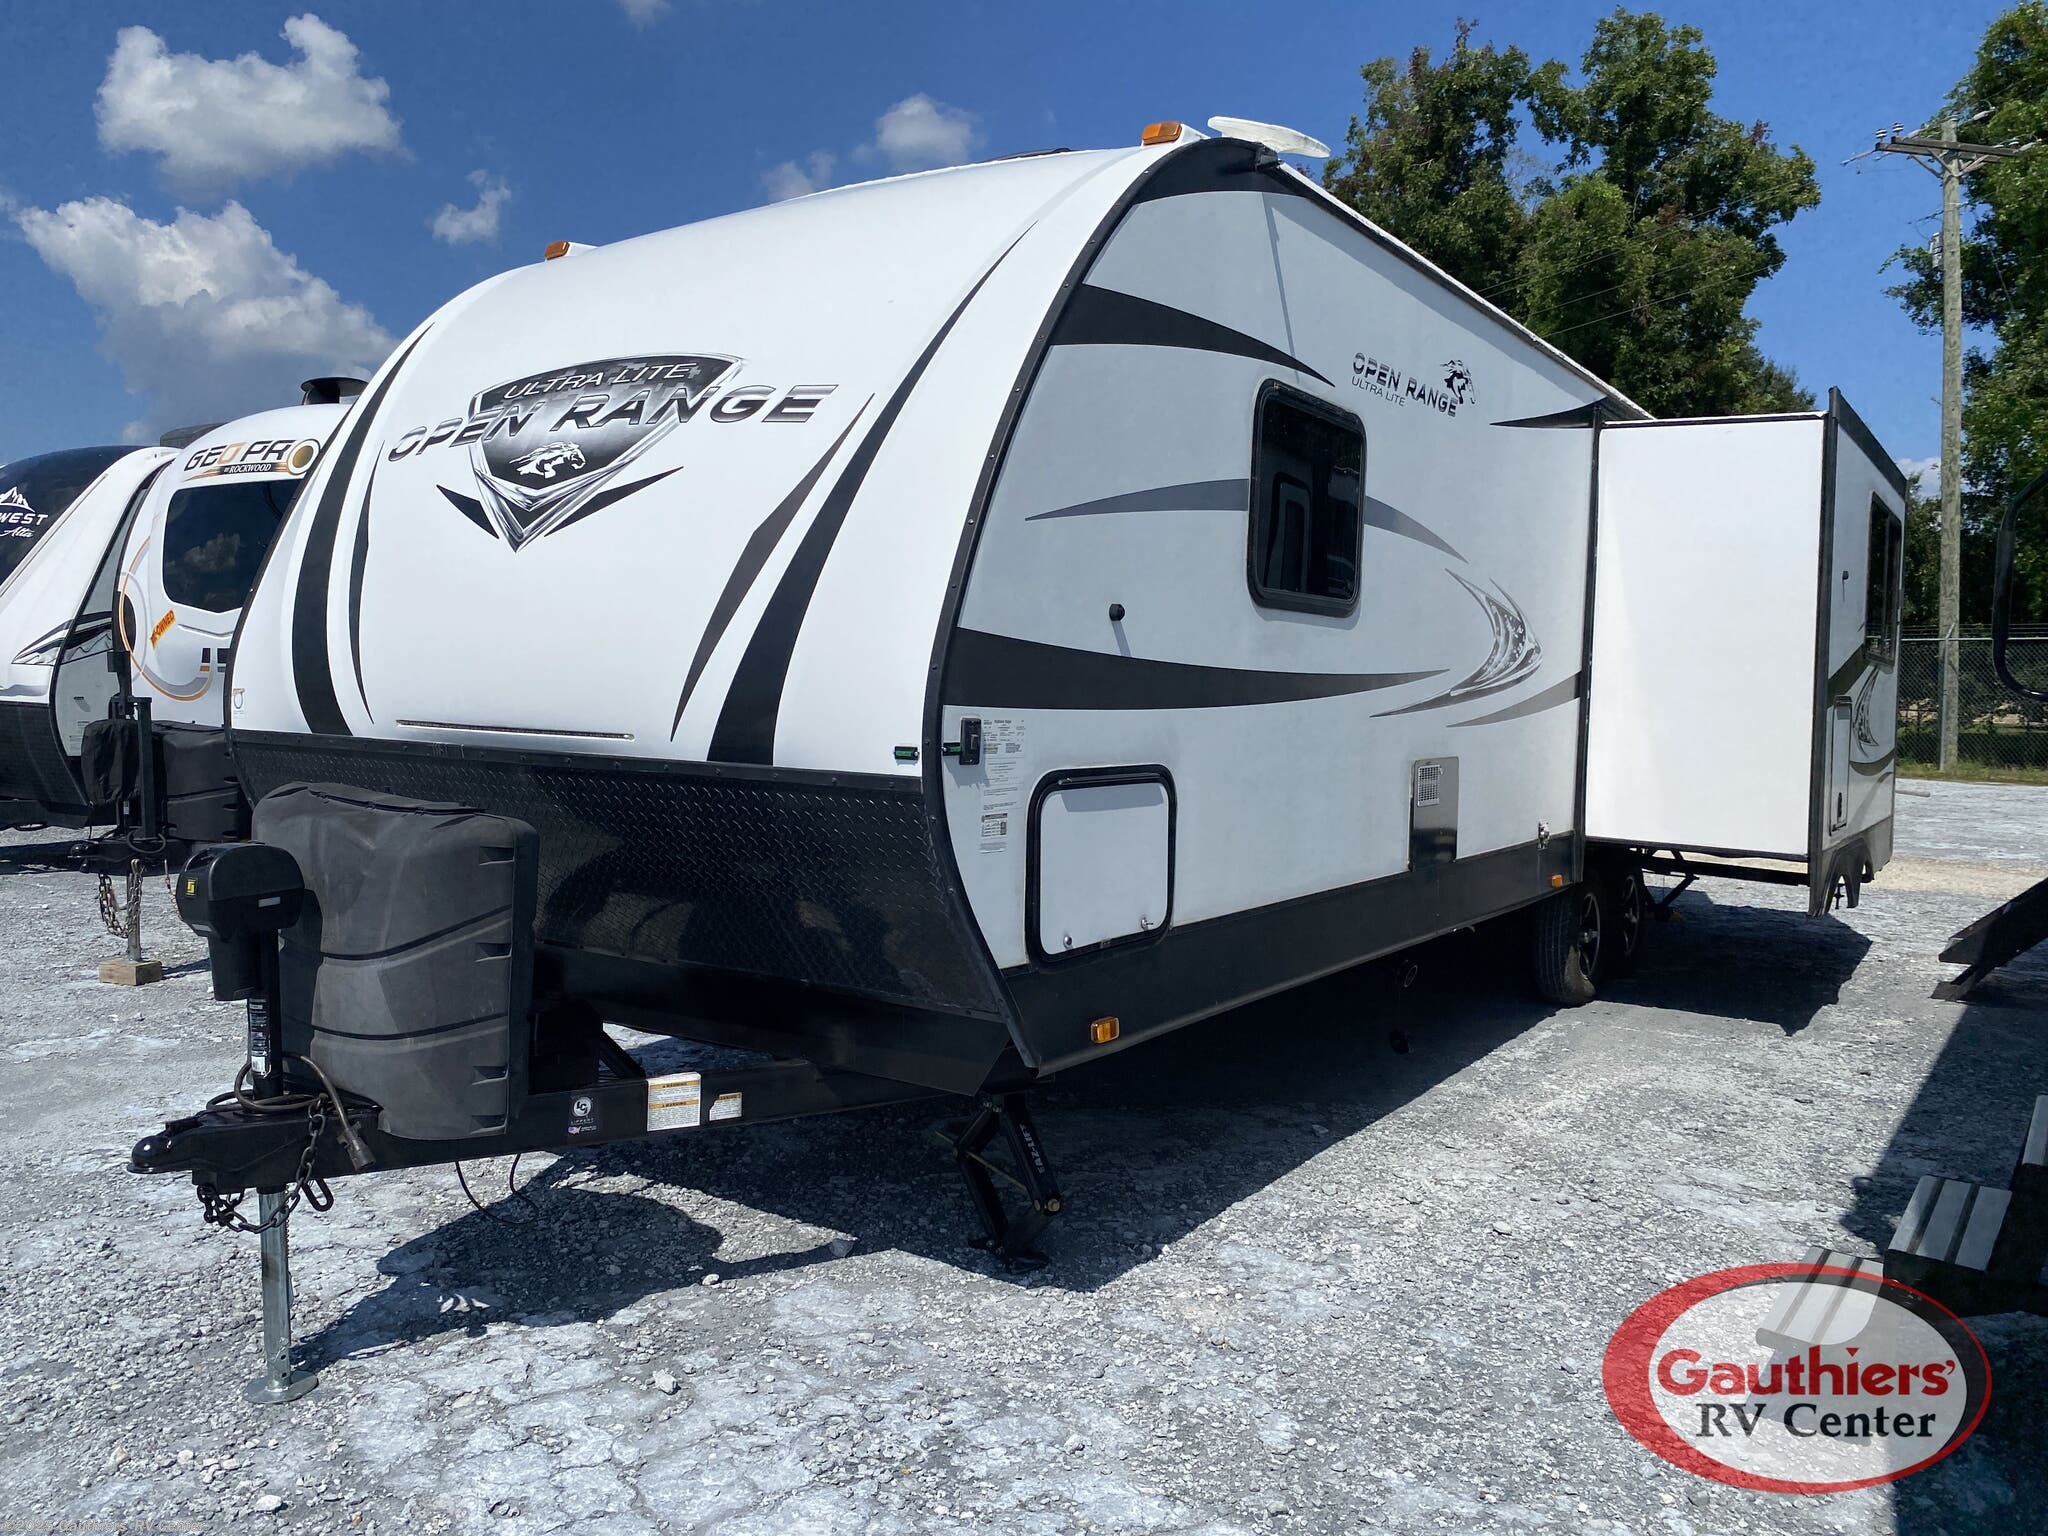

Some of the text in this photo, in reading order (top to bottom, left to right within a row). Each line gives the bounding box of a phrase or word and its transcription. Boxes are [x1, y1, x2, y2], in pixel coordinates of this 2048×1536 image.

[504, 362, 698, 399] ULTRA LITE
[1351, 376, 1406, 407] ULTRA LITE
[1352, 352, 1459, 417] OPEN RANGE
[387, 383, 840, 462] OPEN RANGE
[184, 438, 321, 476] GEO PRO
[229, 463, 272, 474] ROCKWOOD
[0, 512, 49, 526] WEST
